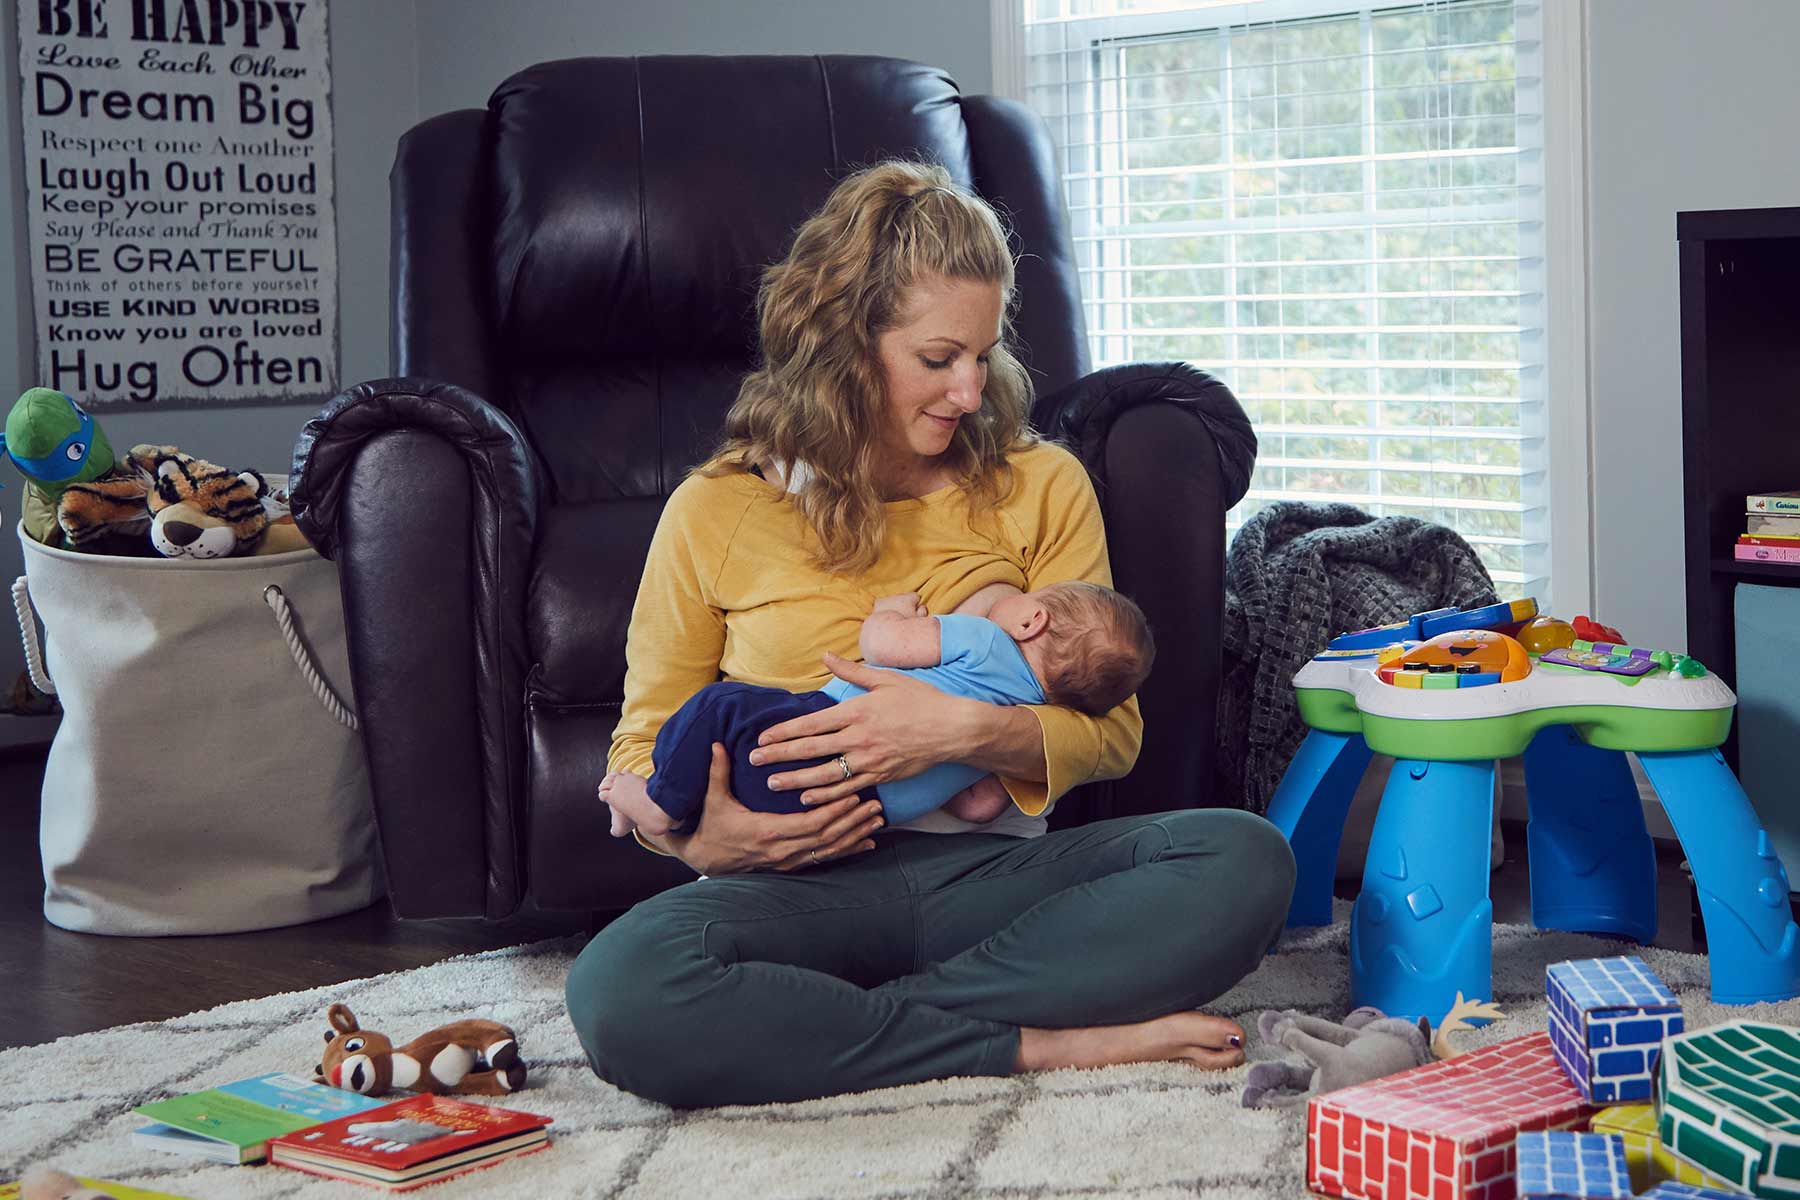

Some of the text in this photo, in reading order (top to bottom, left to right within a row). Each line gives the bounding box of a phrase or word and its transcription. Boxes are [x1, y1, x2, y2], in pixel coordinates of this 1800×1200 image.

[37, 0, 306, 50] BE HAPPY
[37, 43, 306, 79] Love Each Other
[36, 71, 314, 140] Dream Big
[41, 130, 314, 159] Respect one Another
[40, 157, 317, 199] Laugh Out Loud
[42, 193, 317, 219] Keep your promises
[45, 220, 318, 245] Say Please and Thank You
[45, 243, 318, 273] BE GRATEFUL
[46, 278, 319, 293] Think of others before yourself
[49, 298, 320, 317] USE KIND WORDS
[49, 319, 322, 343] Know you are loved
[51, 340, 322, 401] Hug Often
